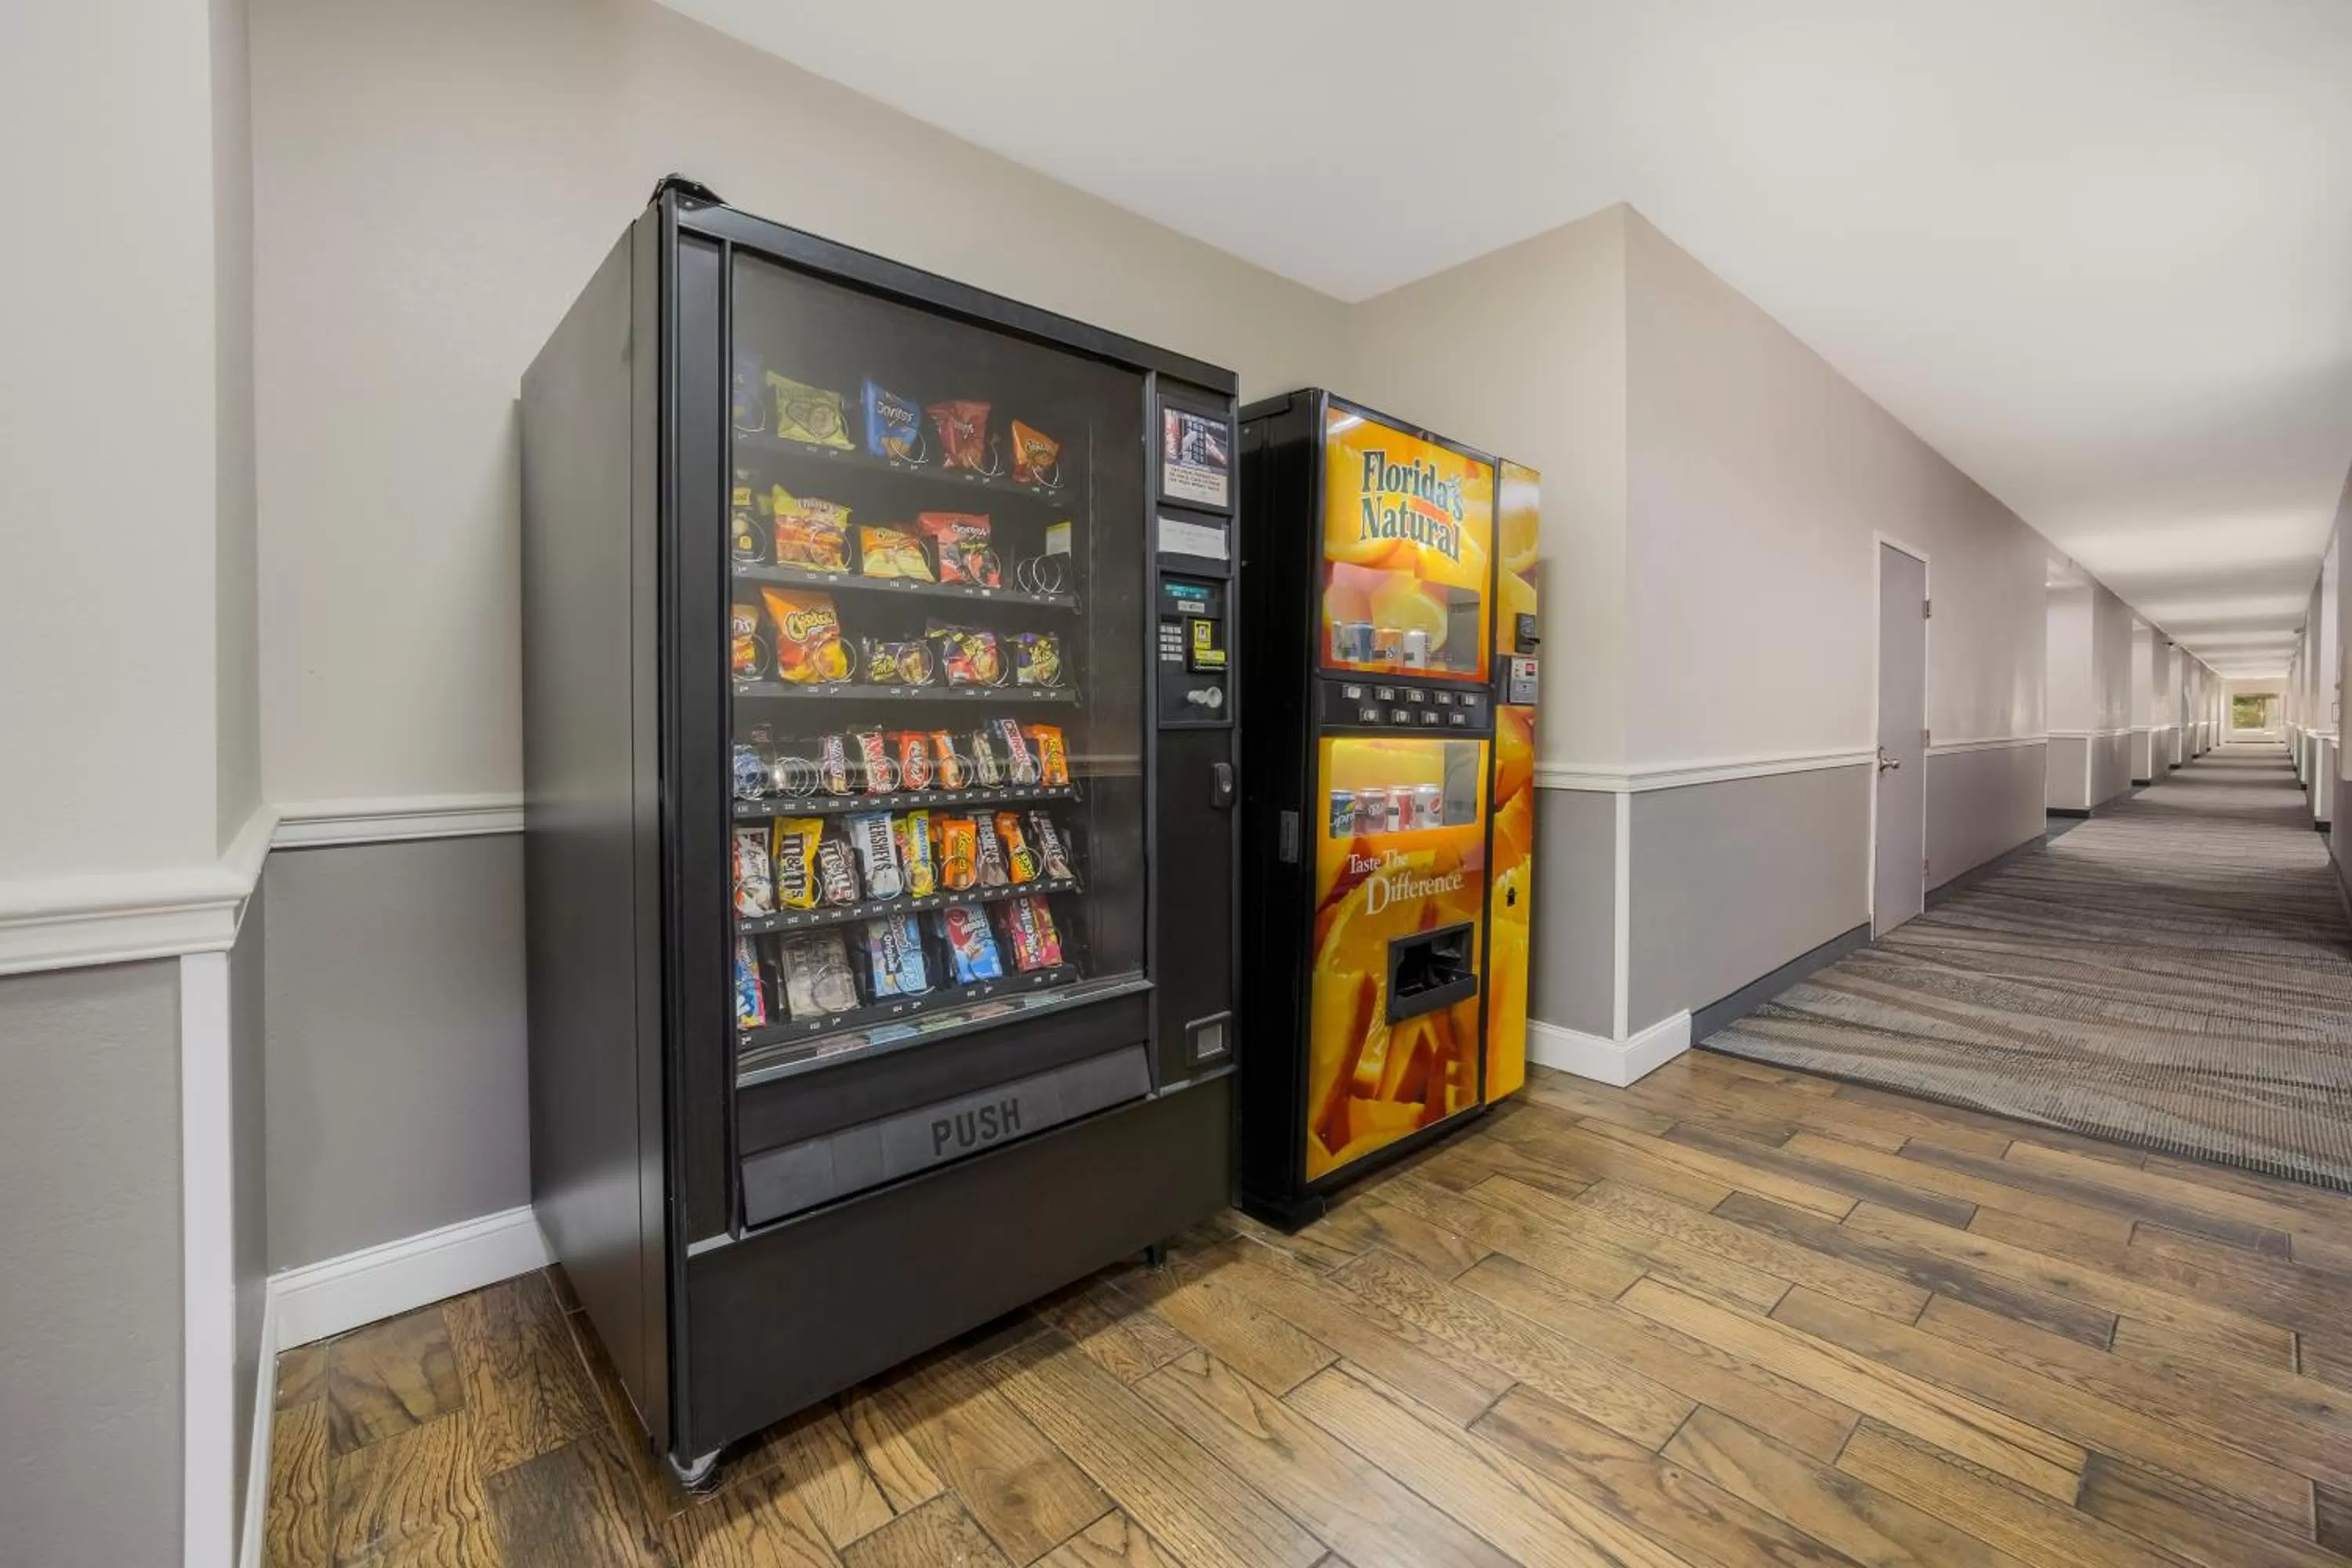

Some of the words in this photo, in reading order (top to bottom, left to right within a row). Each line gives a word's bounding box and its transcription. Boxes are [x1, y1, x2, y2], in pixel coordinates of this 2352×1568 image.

[1361, 450, 1465, 522] Florida's
[1359, 495, 1461, 565] Natural
[1348, 853, 1381, 873] Taste
[1382, 848, 1409, 867] The
[1366, 870, 1464, 916] Difference
[931, 1098, 1022, 1157] PUSH
